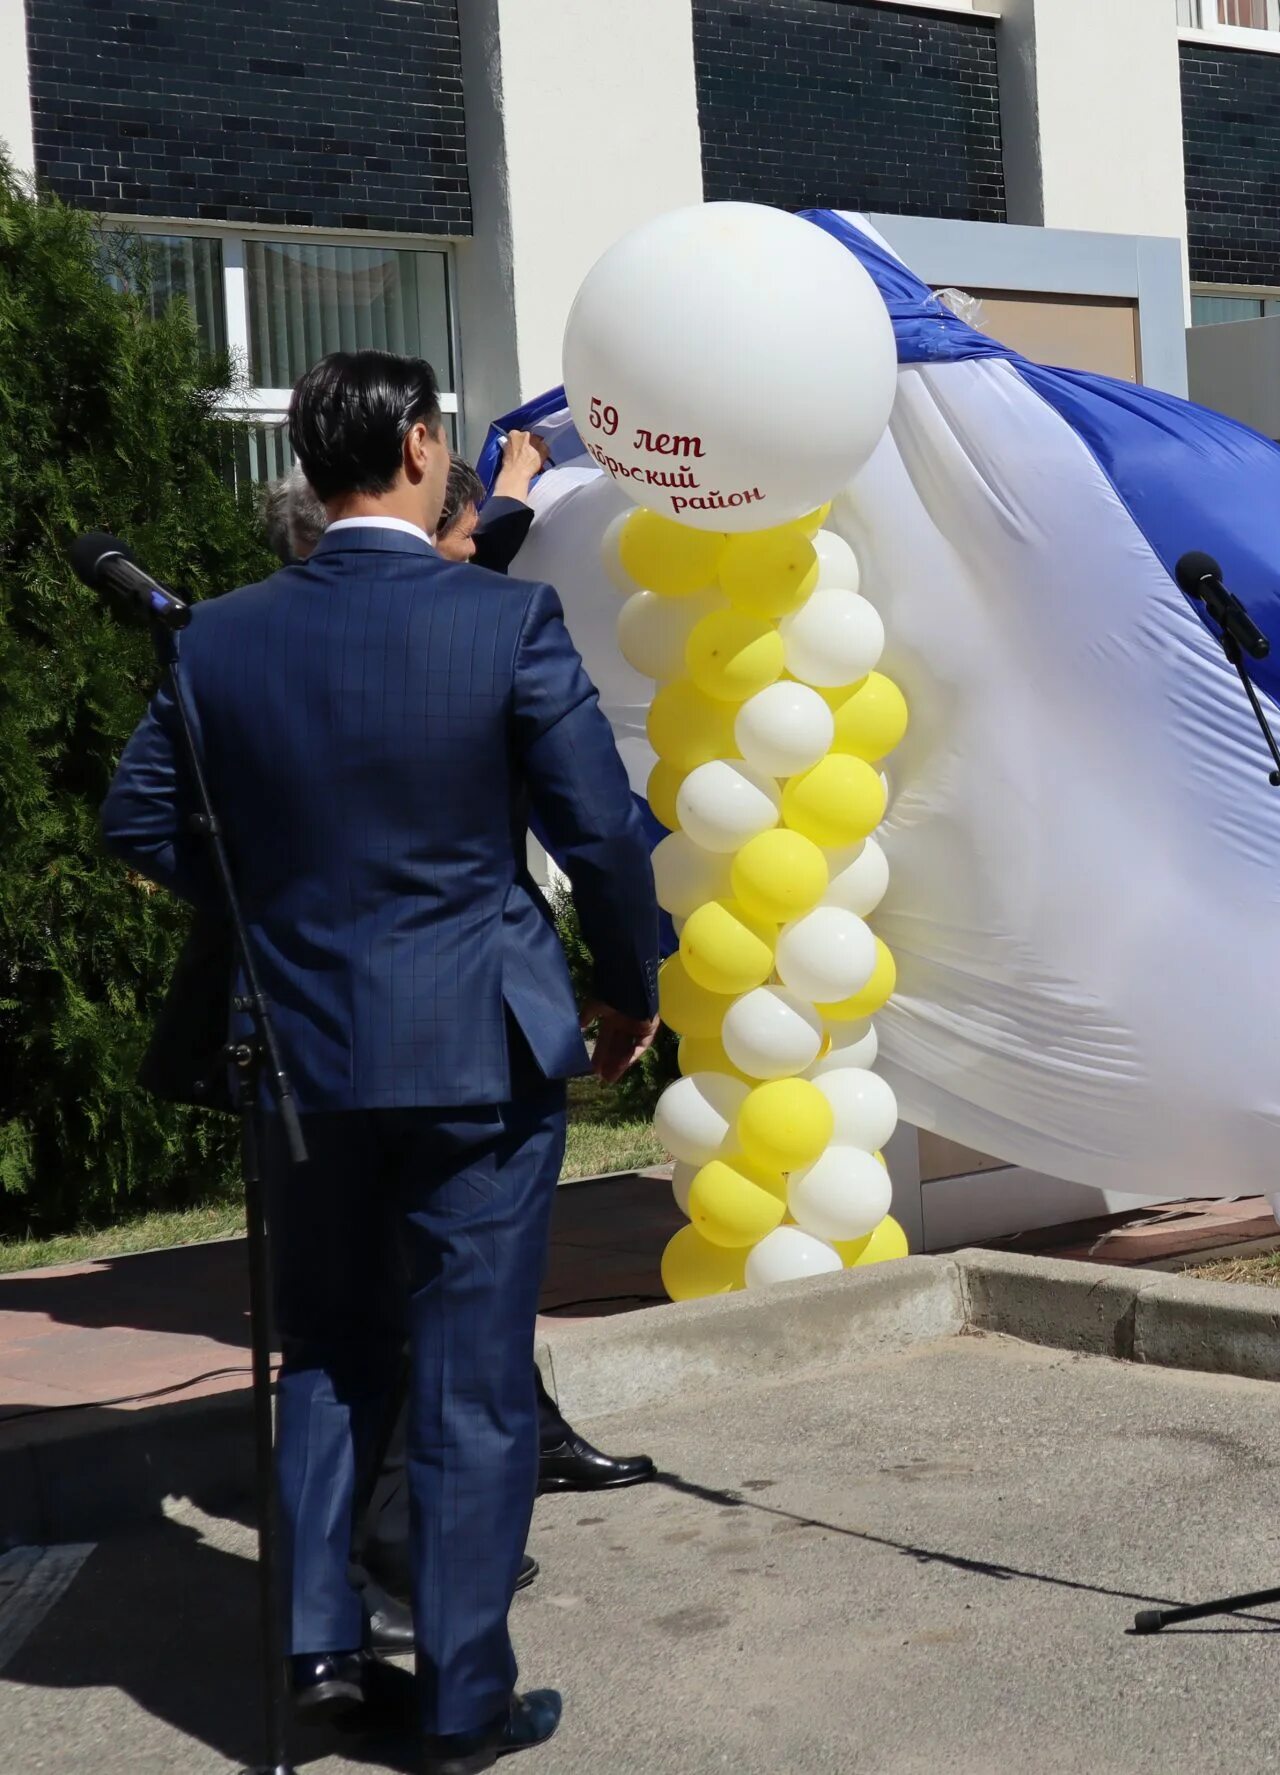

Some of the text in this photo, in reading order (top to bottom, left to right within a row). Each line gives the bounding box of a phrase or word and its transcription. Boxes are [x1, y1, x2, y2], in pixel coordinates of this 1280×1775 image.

[589, 396, 706, 458] 59 лет
[584, 440, 700, 489] ябрьский
[669, 487, 766, 514] район
